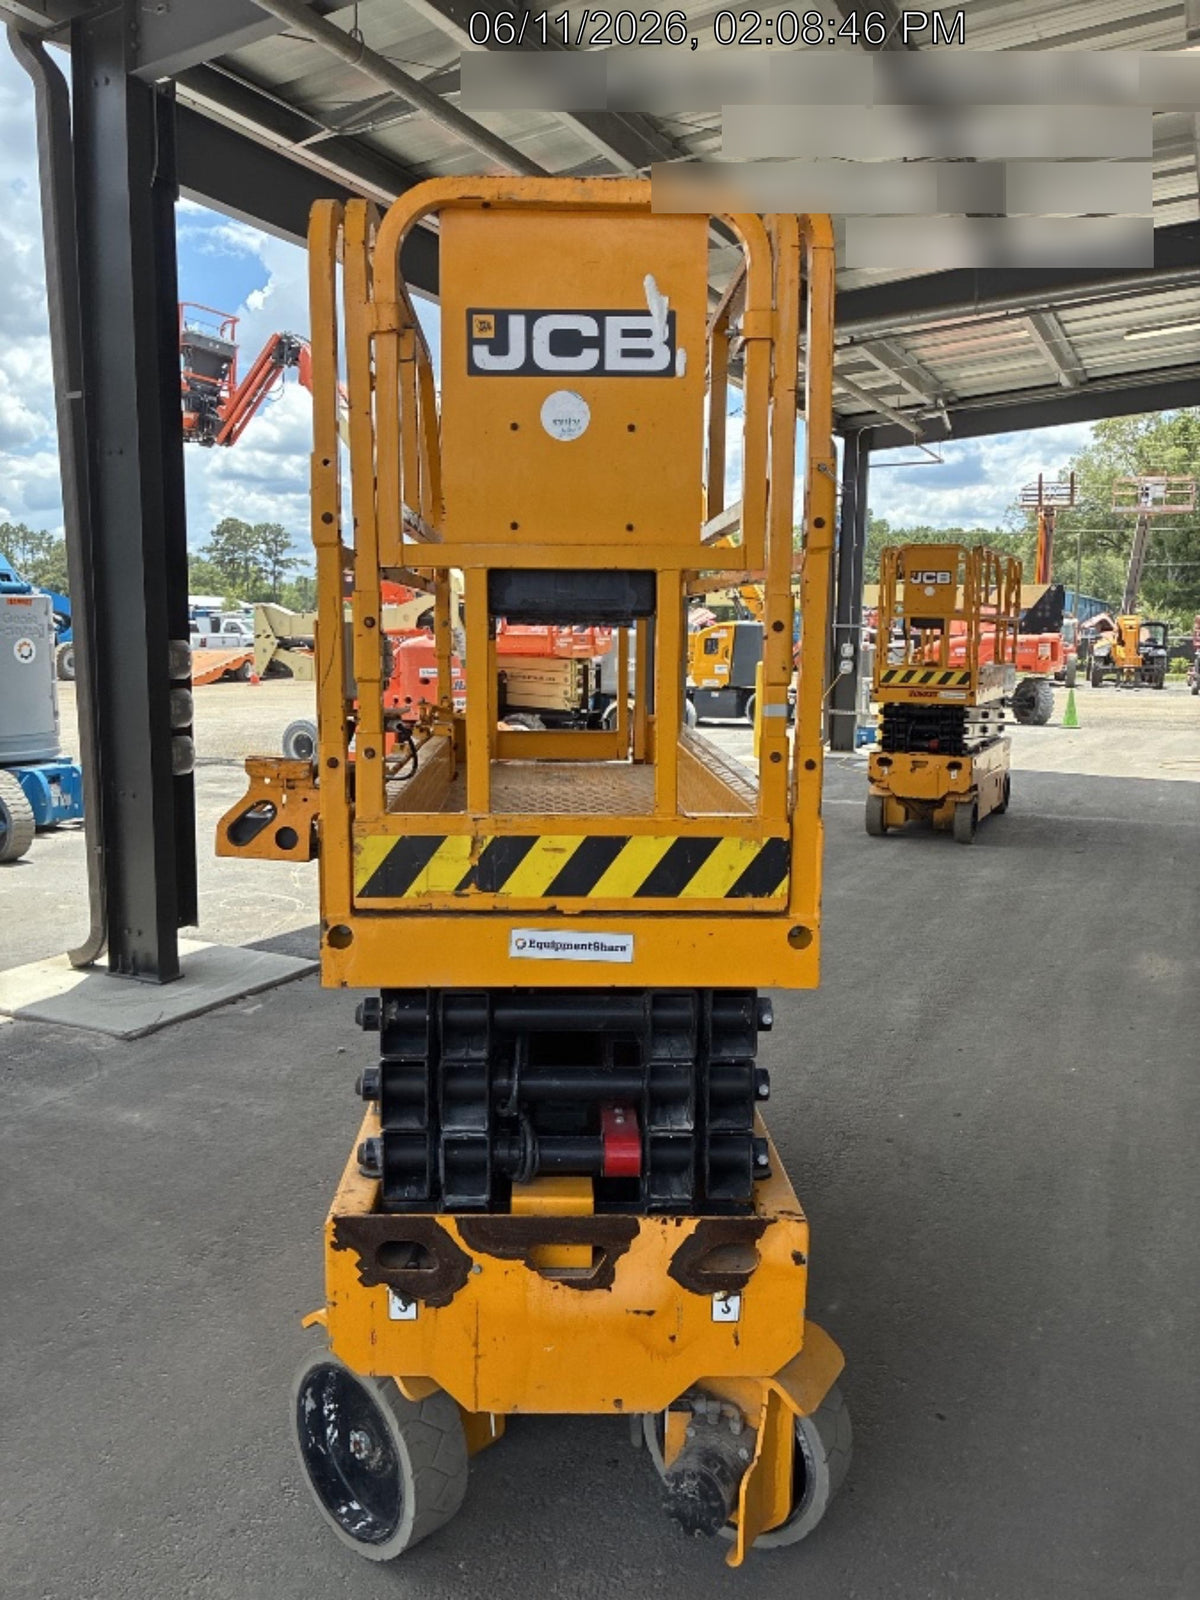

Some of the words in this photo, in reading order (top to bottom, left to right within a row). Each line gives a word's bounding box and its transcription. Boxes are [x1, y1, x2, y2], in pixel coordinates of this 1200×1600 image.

[472, 313, 671, 371] JCB
[911, 571, 951, 584] JCB
[528, 938, 627, 952] EquipmentShare
